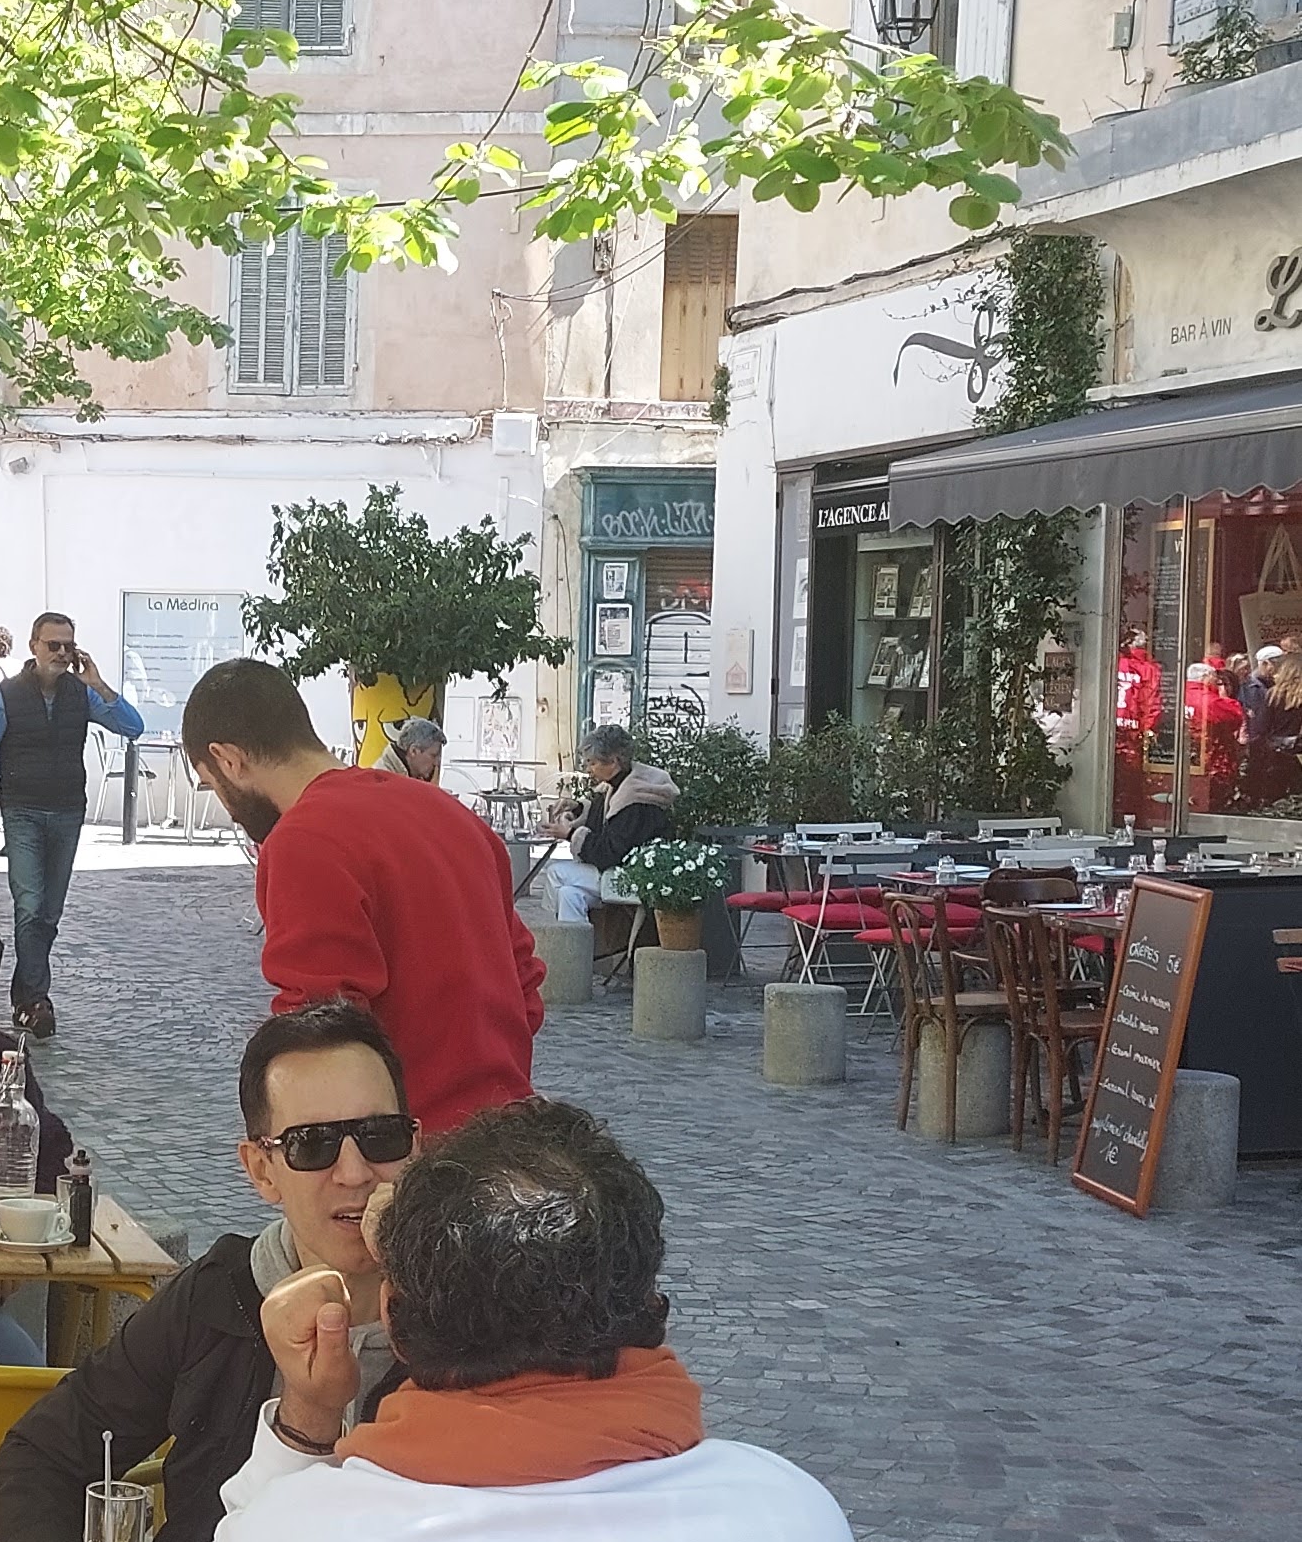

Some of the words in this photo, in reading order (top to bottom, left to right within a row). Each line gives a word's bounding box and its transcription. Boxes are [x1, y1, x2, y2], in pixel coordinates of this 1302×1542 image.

[1171, 324, 1196, 345] BAR
[1200, 316, 1208, 340] À
[1211, 317, 1232, 337] VIN
[817, 503, 878, 528] L'AGENCE
[148, 597, 163, 611] La
[167, 597, 219, 611] Médina
[1100, 1141, 1118, 1165] 1€
